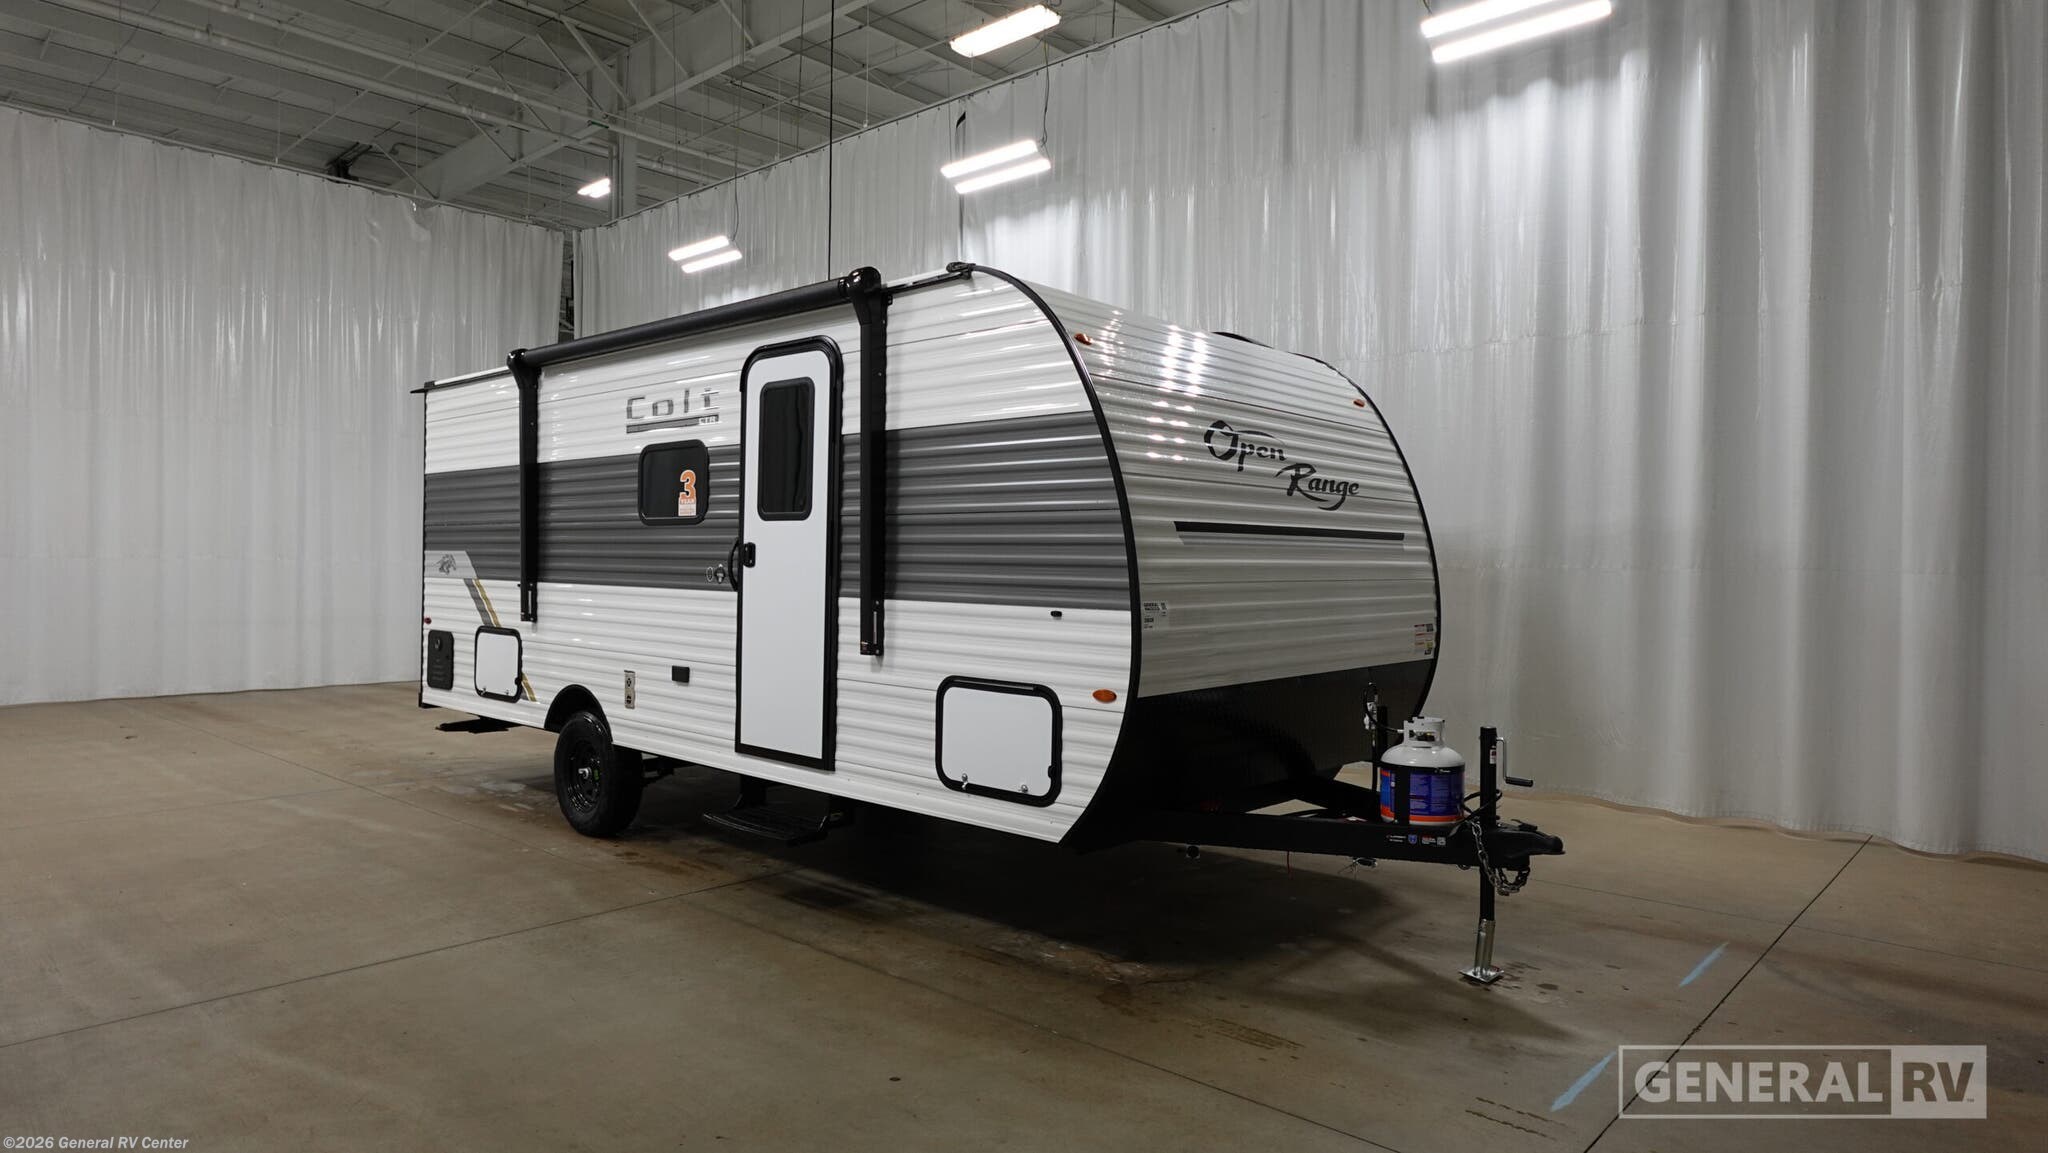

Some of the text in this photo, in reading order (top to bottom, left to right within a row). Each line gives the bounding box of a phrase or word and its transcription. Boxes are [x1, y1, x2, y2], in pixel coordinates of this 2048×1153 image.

[1204, 420, 1286, 472] Open
[679, 470, 696, 499] 3
[1274, 462, 1360, 511] Range
